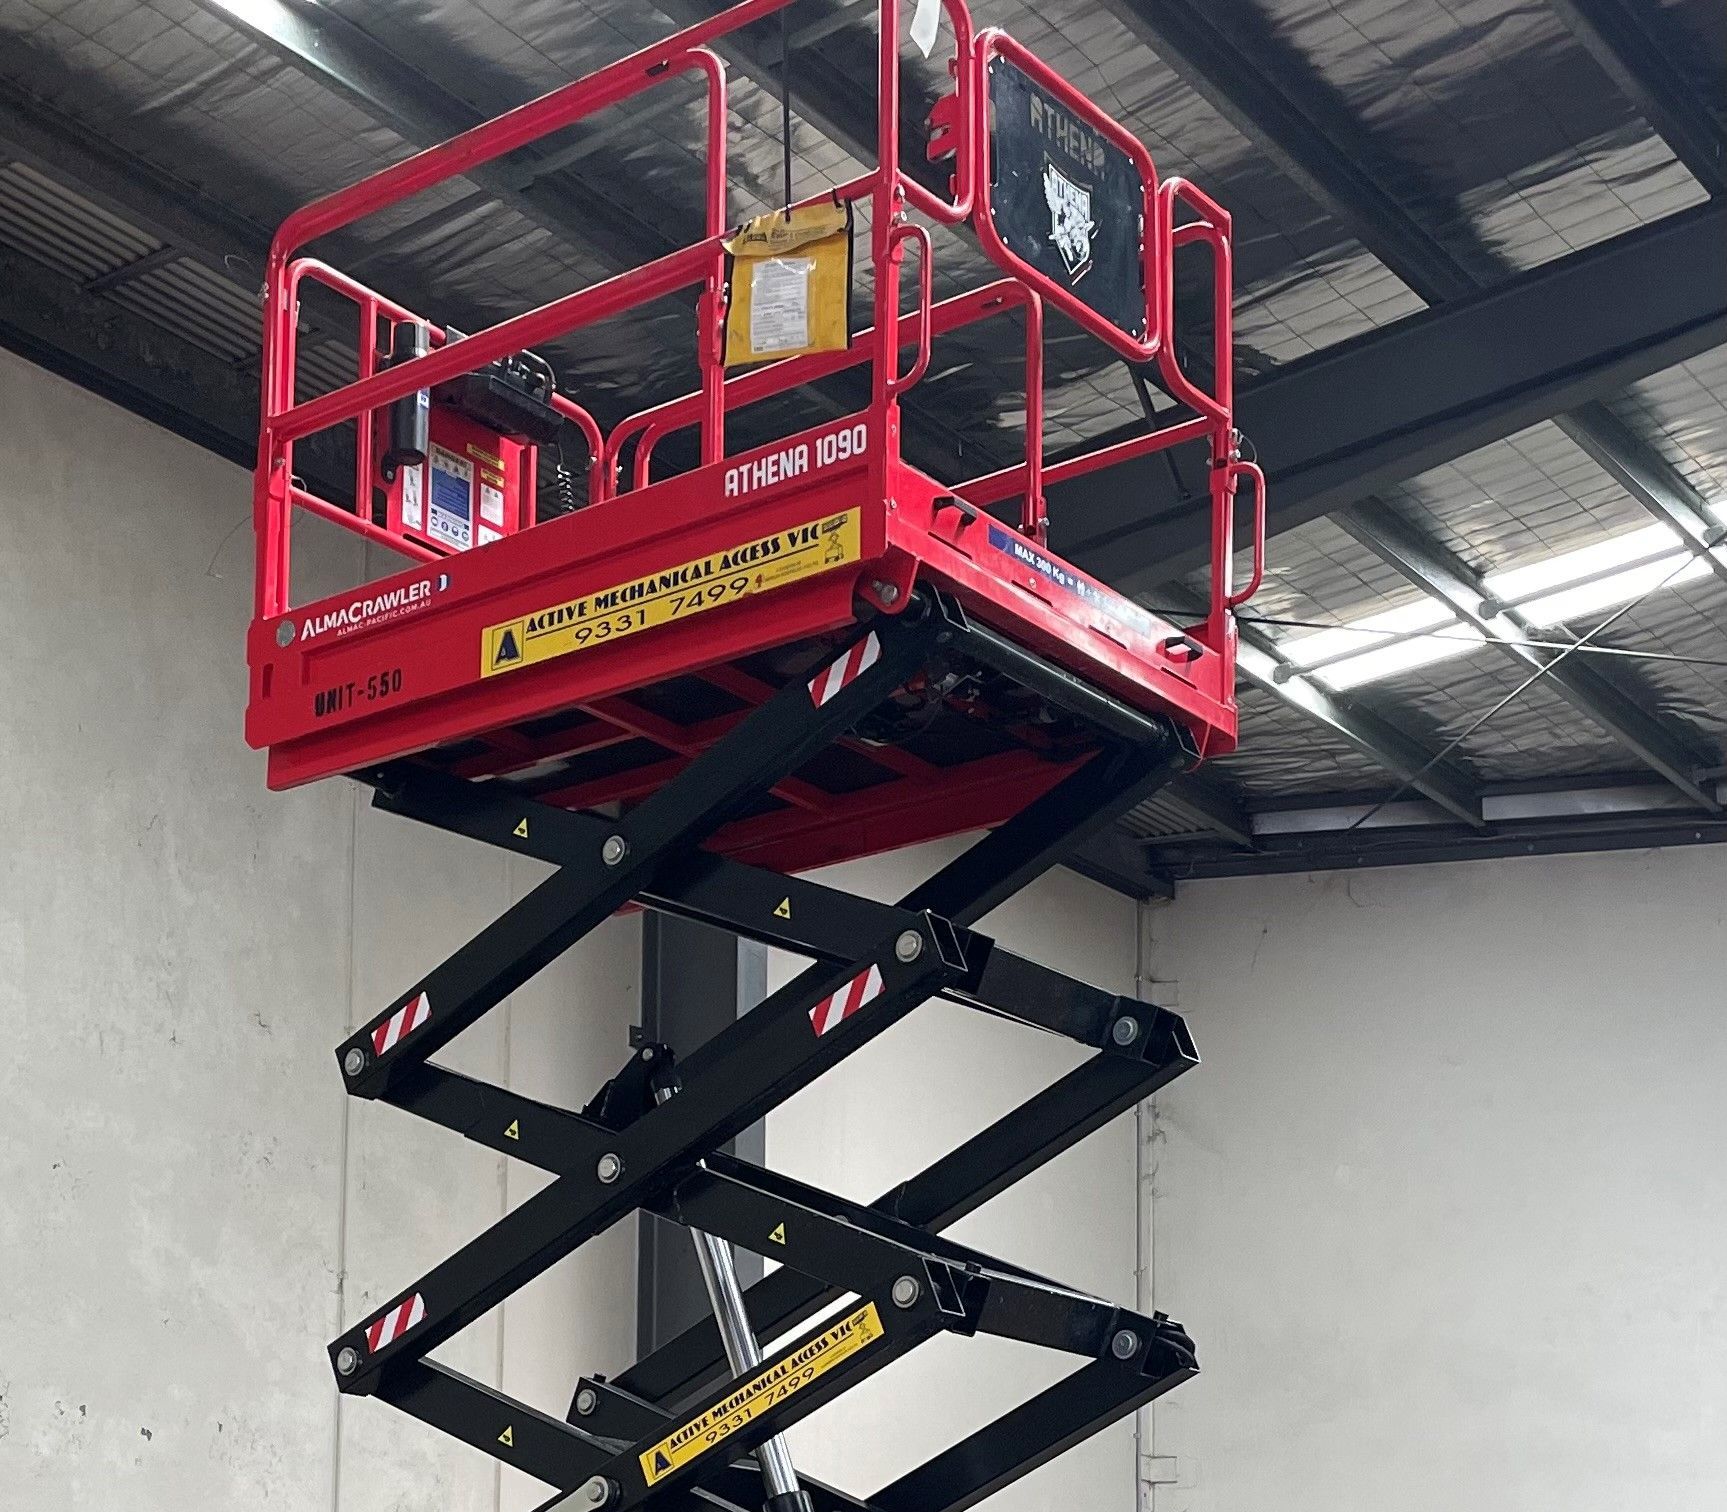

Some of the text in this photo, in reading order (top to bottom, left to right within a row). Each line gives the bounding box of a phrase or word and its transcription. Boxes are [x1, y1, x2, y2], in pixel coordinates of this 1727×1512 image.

[1029, 92, 1105, 181] ATHENA
[724, 423, 867, 497] ATHENA 1090
[525, 600, 588, 633] ACTIVE
[594, 560, 714, 613] MECHANICAL
[719, 537, 781, 570] ACCESS
[787, 523, 819, 547] VIC
[1014, 543, 1035, 565] MAX
[301, 580, 432, 641] ALMACRAWLER
[573, 577, 750, 645] 9331 7499
[314, 668, 403, 717] UNIT-550
[669, 1416, 709, 1450] ACTIVE
[711, 1366, 789, 1419] MECHANICAL
[791, 1338, 829, 1370] ACCESS
[830, 1320, 853, 1342] VIC
[705, 1366, 815, 1444] 9331 7499
